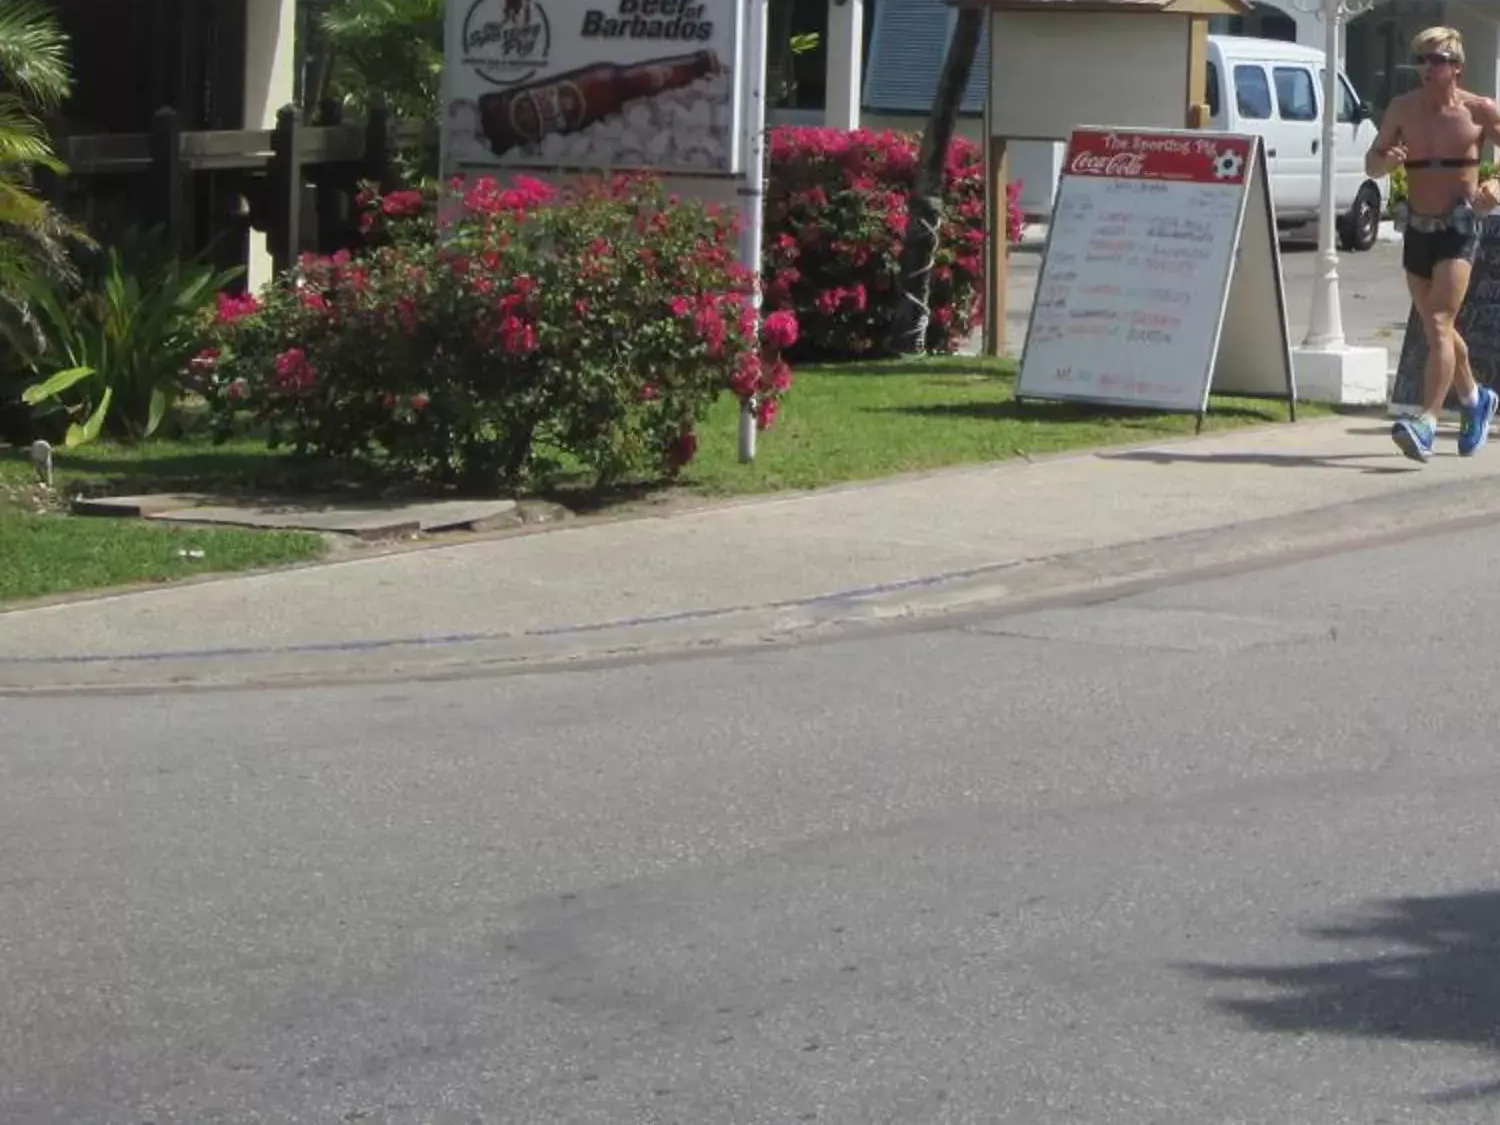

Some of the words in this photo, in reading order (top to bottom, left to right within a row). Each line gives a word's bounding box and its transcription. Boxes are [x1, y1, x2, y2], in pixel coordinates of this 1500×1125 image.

[686, 3, 706, 19] of
[579, 10, 714, 41] Barbados
[1103, 132, 1127, 151] The
